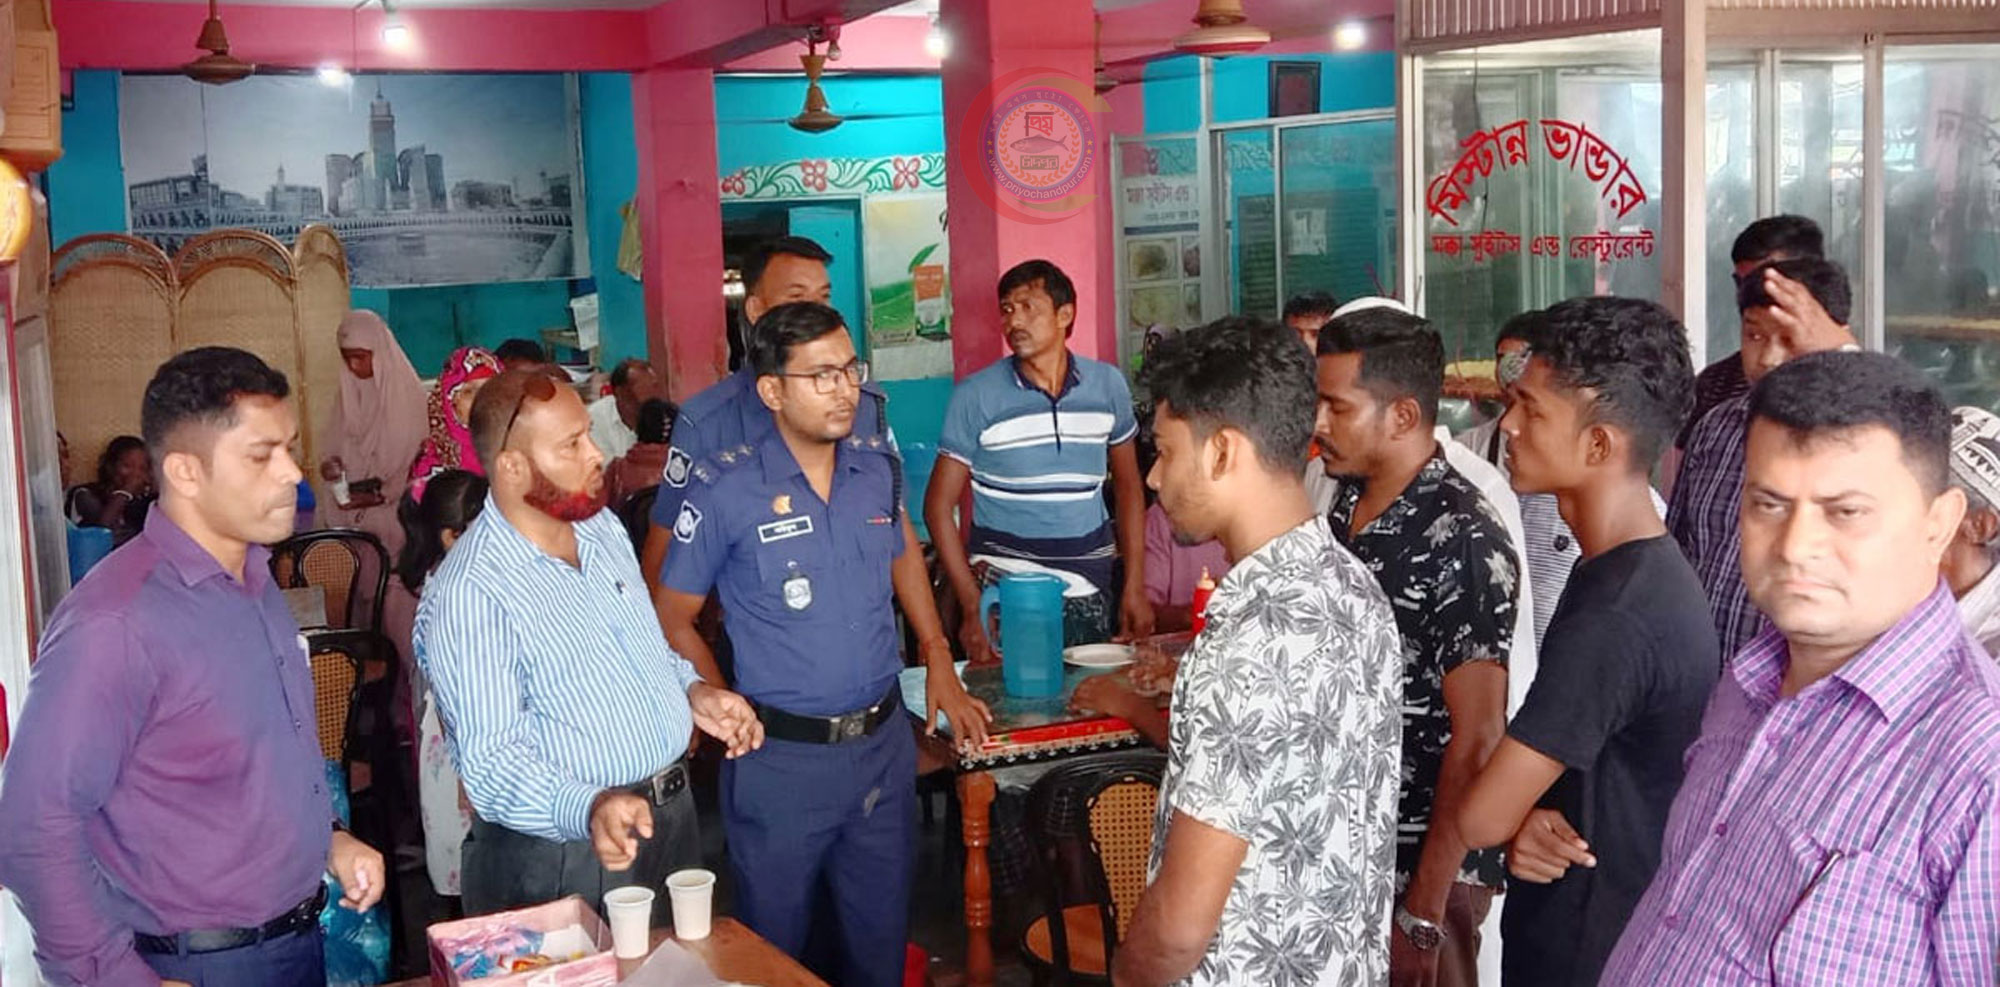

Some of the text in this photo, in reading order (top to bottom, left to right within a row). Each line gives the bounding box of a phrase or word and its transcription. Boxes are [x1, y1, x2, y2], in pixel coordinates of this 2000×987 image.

[1427, 119, 1647, 226] মিস্টান্ন ভান্ডার
[1569, 230, 1654, 262] রেস্টুরেন্ট
